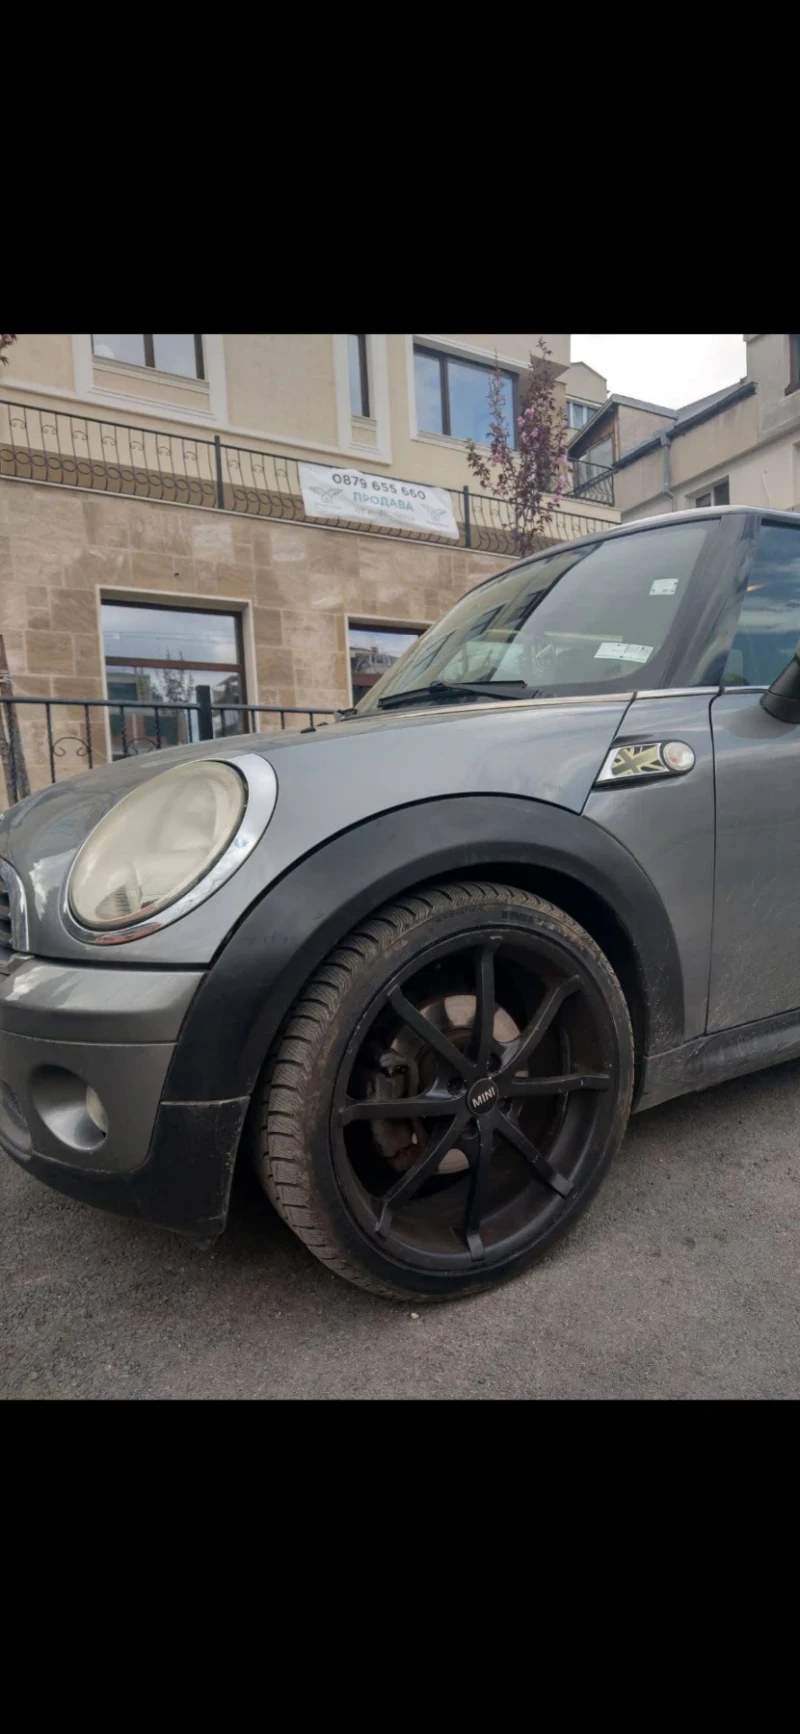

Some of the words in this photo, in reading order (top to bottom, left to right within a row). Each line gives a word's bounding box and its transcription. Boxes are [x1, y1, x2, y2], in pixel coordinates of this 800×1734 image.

[332, 473, 368, 489] 0879
[372, 481, 398, 494] 655
[401, 487, 427, 500] 660
[353, 492, 414, 511] ПРОДАВА
[472, 1086, 496, 1108] MINI
